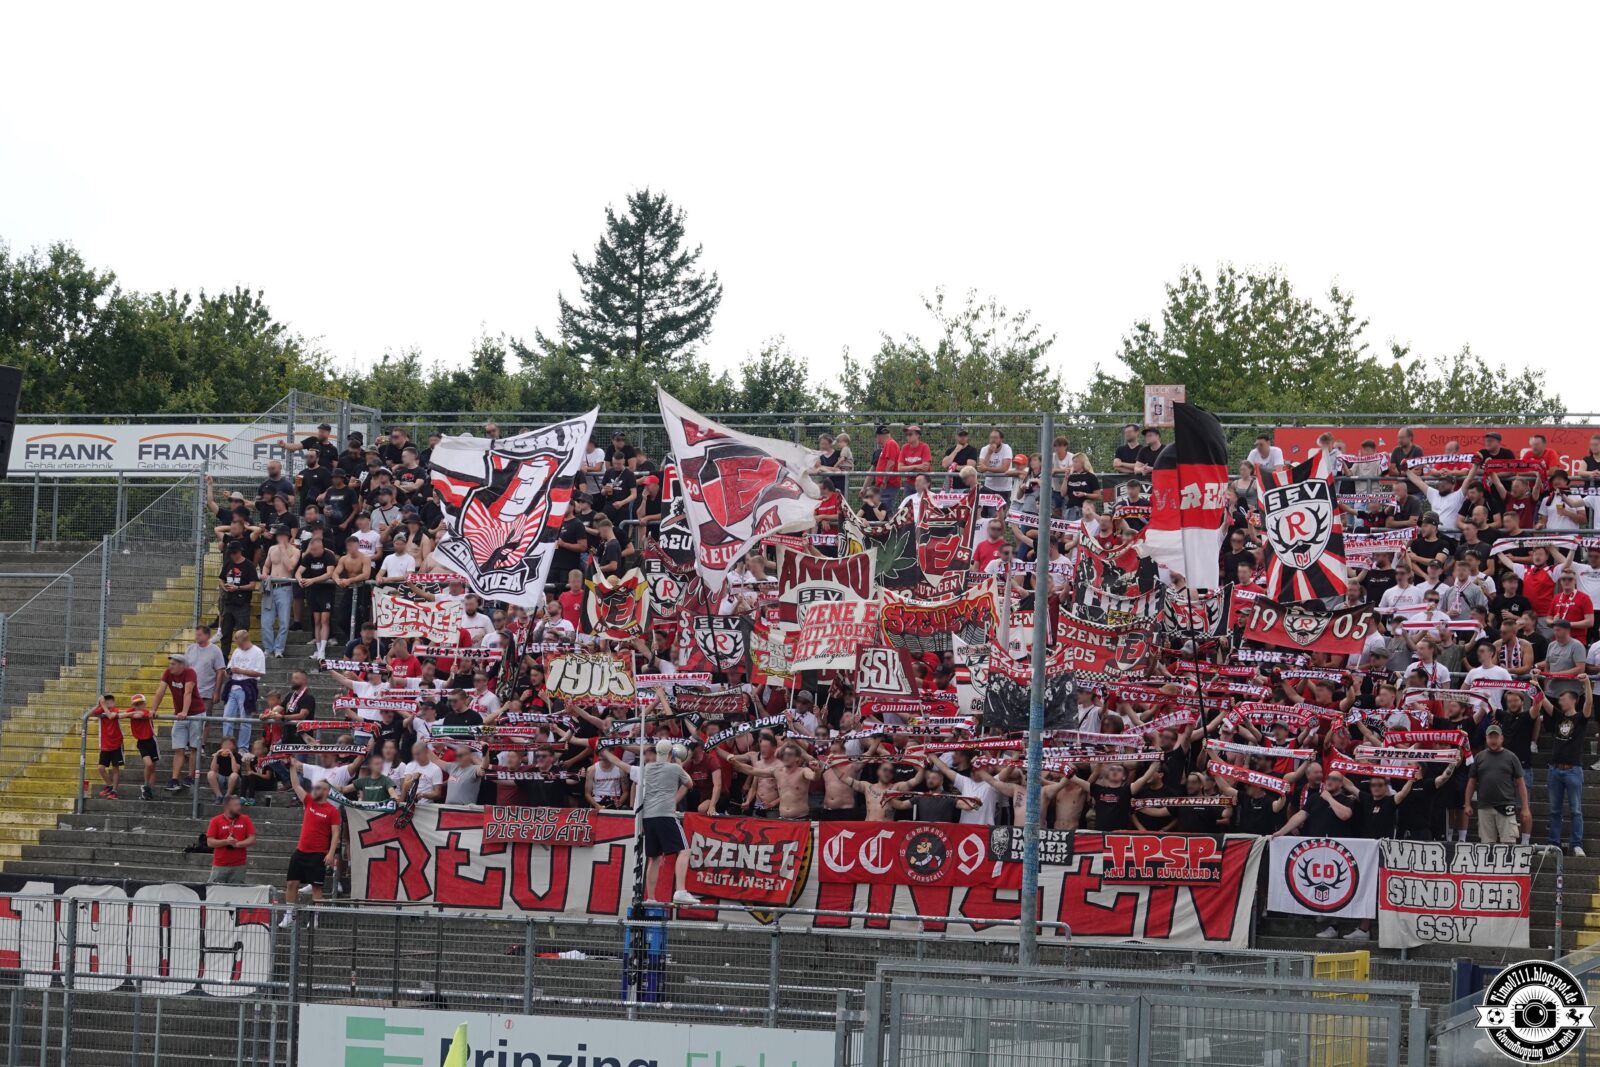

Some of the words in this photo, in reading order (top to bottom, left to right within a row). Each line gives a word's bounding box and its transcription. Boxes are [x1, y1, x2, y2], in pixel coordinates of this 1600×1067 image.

[25, 444, 114, 460] FRANK
[138, 444, 228, 460] FRANK
[253, 443, 307, 460] FRA
[1407, 454, 1474, 468] KREUZEICHE
[1268, 482, 1325, 511] SSV
[1285, 511, 1310, 541] R
[956, 550, 970, 561] 05
[779, 550, 870, 600] ANNO
[804, 602, 858, 626] ZENE
[1250, 604, 1278, 633] 19
[699, 617, 741, 629] SSV
[1332, 612, 1373, 641] 05
[1057, 622, 1112, 647] SZENE
[325, 659, 360, 671] BLOCK
[1238, 650, 1281, 663] BLOCK
[546, 658, 635, 697] 1905
[1252, 702, 1300, 713] REUTLINGEN
[508, 712, 549, 723] BLOCK
[1405, 732, 1459, 742] STUTTGART
[926, 742, 966, 750] OMMANDO
[1373, 749, 1438, 759] STUTTGART
[498, 771, 543, 780] BLOCK
[1248, 772, 1282, 789] SZENE
[567, 807, 590, 825] AI
[485, 822, 594, 843] DIFFIDATI
[689, 831, 774, 874] SZENE
[779, 840, 800, 881] E
[1105, 834, 1218, 870] TPSP
[1380, 839, 1447, 874] WIR
[1450, 843, 1533, 875] ALLE
[696, 871, 787, 892] REUTLINGEN
[1110, 867, 1124, 878] NO
[1128, 867, 1136, 878] A
[1140, 867, 1153, 878] LA
[1157, 867, 1211, 880] AUTORIDAD
[1387, 876, 1457, 909] SIND
[1460, 880, 1522, 911] DER
[1416, 914, 1478, 943] SSV
